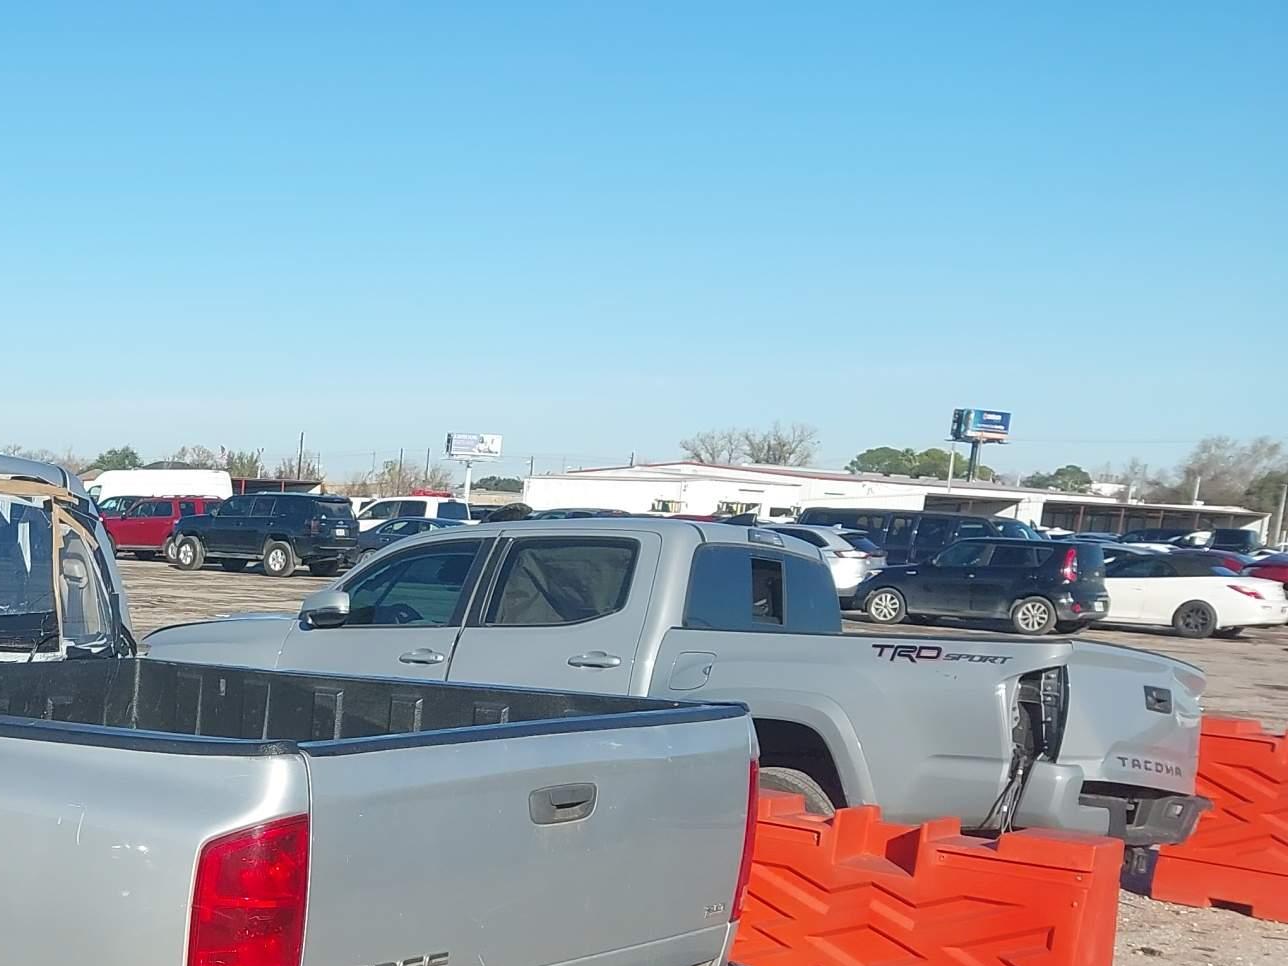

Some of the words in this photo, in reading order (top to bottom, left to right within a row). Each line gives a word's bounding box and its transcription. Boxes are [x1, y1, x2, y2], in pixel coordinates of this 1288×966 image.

[871, 643, 943, 664] TRD
[943, 653, 1013, 665] SPORT
[1116, 756, 1183, 777] TACOMA
